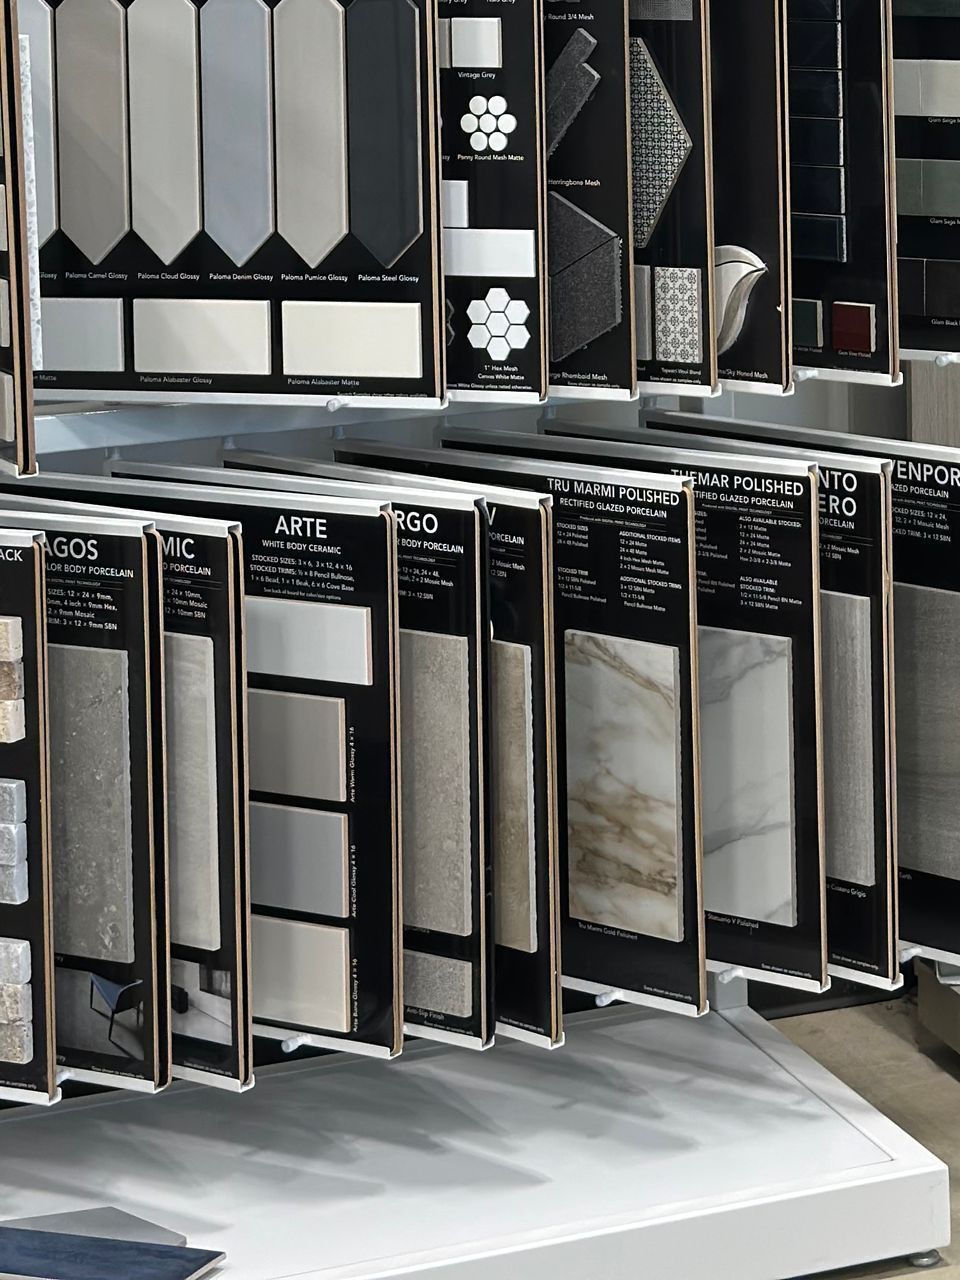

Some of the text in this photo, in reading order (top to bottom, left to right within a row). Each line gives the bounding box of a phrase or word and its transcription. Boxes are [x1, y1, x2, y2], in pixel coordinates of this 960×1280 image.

[458, 72, 496, 80] Vintage Grey
[138, 272, 159, 280] Paloma
[179, 273, 200, 281] Glossy
[398, 275, 419, 283] Glossy
[547, 478, 680, 505] TRU MARMI POLISHED
[734, 476, 804, 496] POLISHED
[910, 486, 949, 498] PORCELAIN
[560, 497, 667, 518] RECTIFIED GLAZED PORCELAIN
[720, 493, 794, 509] GLAZED PORCELAIN
[275, 515, 328, 539] ARTE
[262, 539, 341, 554] WHITE BODY CERAMIC
[401, 540, 464, 554] BODY PORCELAIN
[64, 564, 134, 578] BODY PORCELAIN
[169, 564, 211, 576] PORCELAIN
